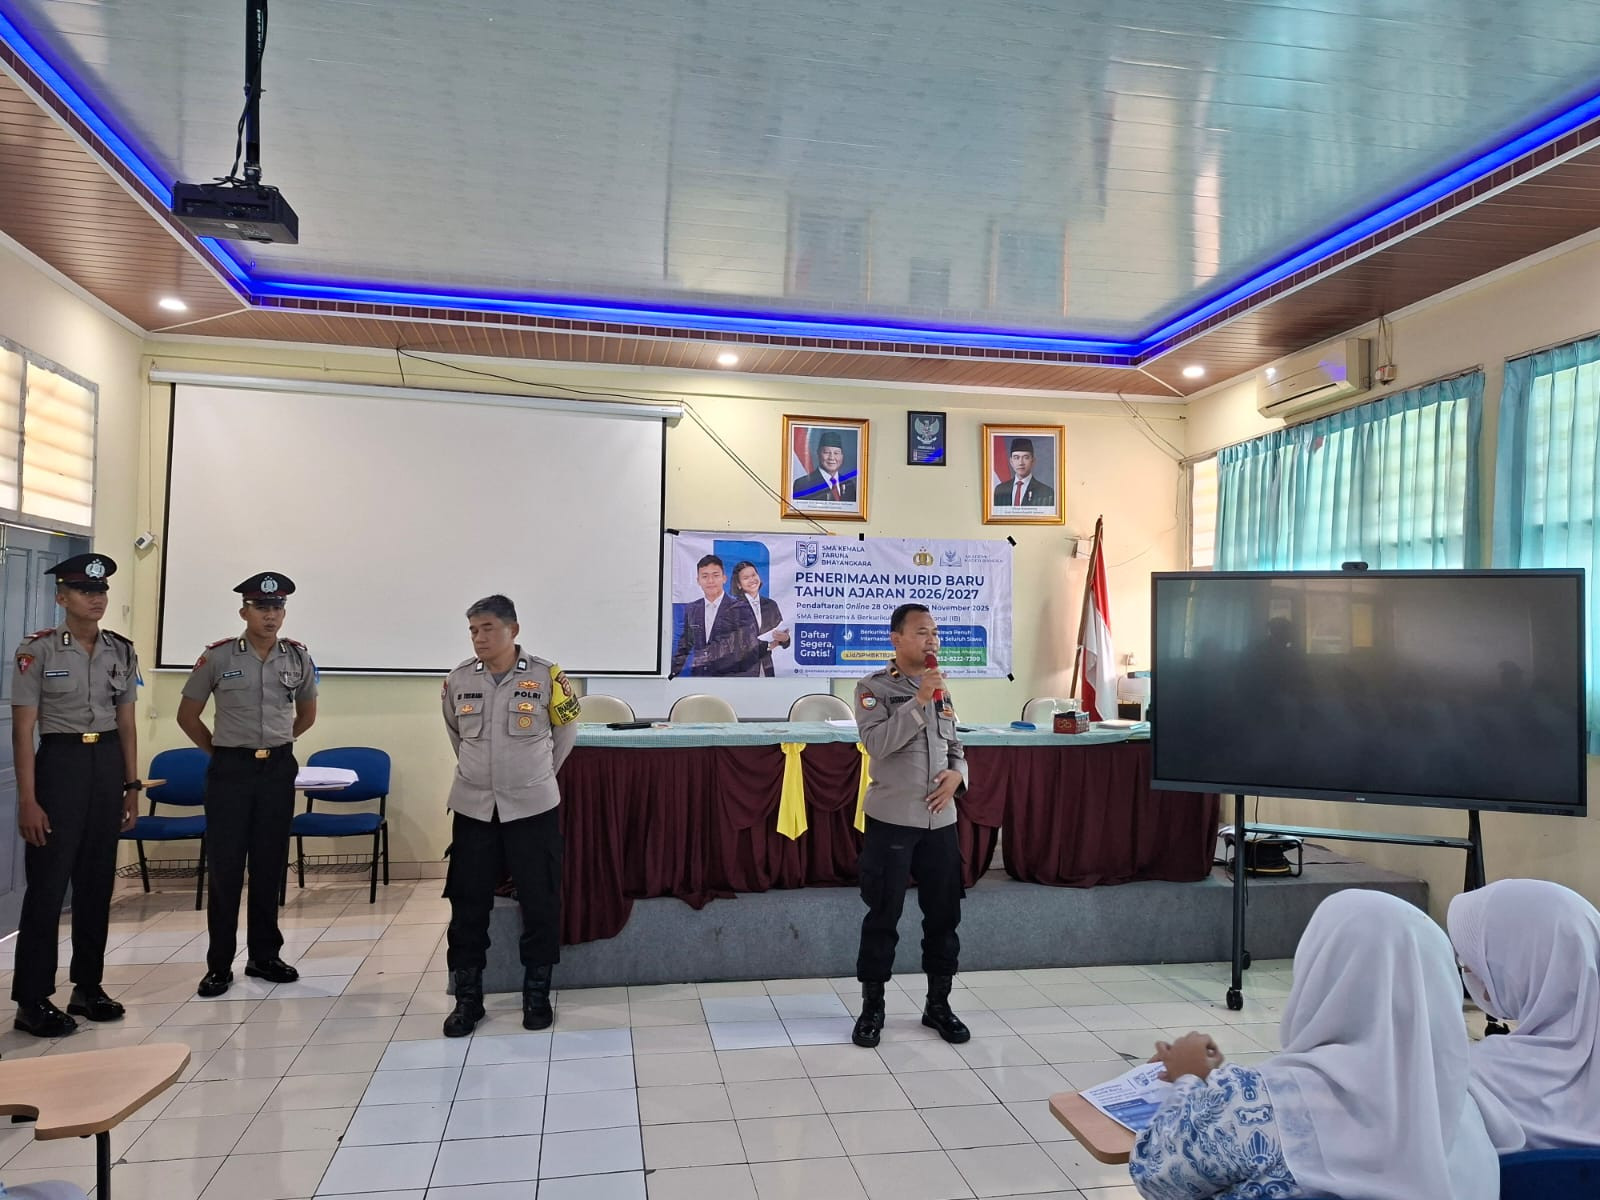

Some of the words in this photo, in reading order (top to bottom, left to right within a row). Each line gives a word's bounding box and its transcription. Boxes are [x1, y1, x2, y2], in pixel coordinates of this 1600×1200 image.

[821, 559, 872, 567] BHAYANGKARA
[795, 572, 890, 585] PENERIMAAN
[894, 574, 942, 586] MURID
[945, 575, 985, 587] BARU
[794, 586, 845, 598] TAHUN
[848, 587, 905, 599] AJARAN
[909, 587, 979, 601] 2026/2027
[796, 602, 844, 610] Pendaftaran
[846, 602, 870, 610] Online
[882, 603, 897, 611] Okt
[800, 630, 830, 639] Daftar
[800, 640, 835, 650] Segera,
[800, 649, 830, 657] Gratis!
[514, 691, 542, 699] POLRI
